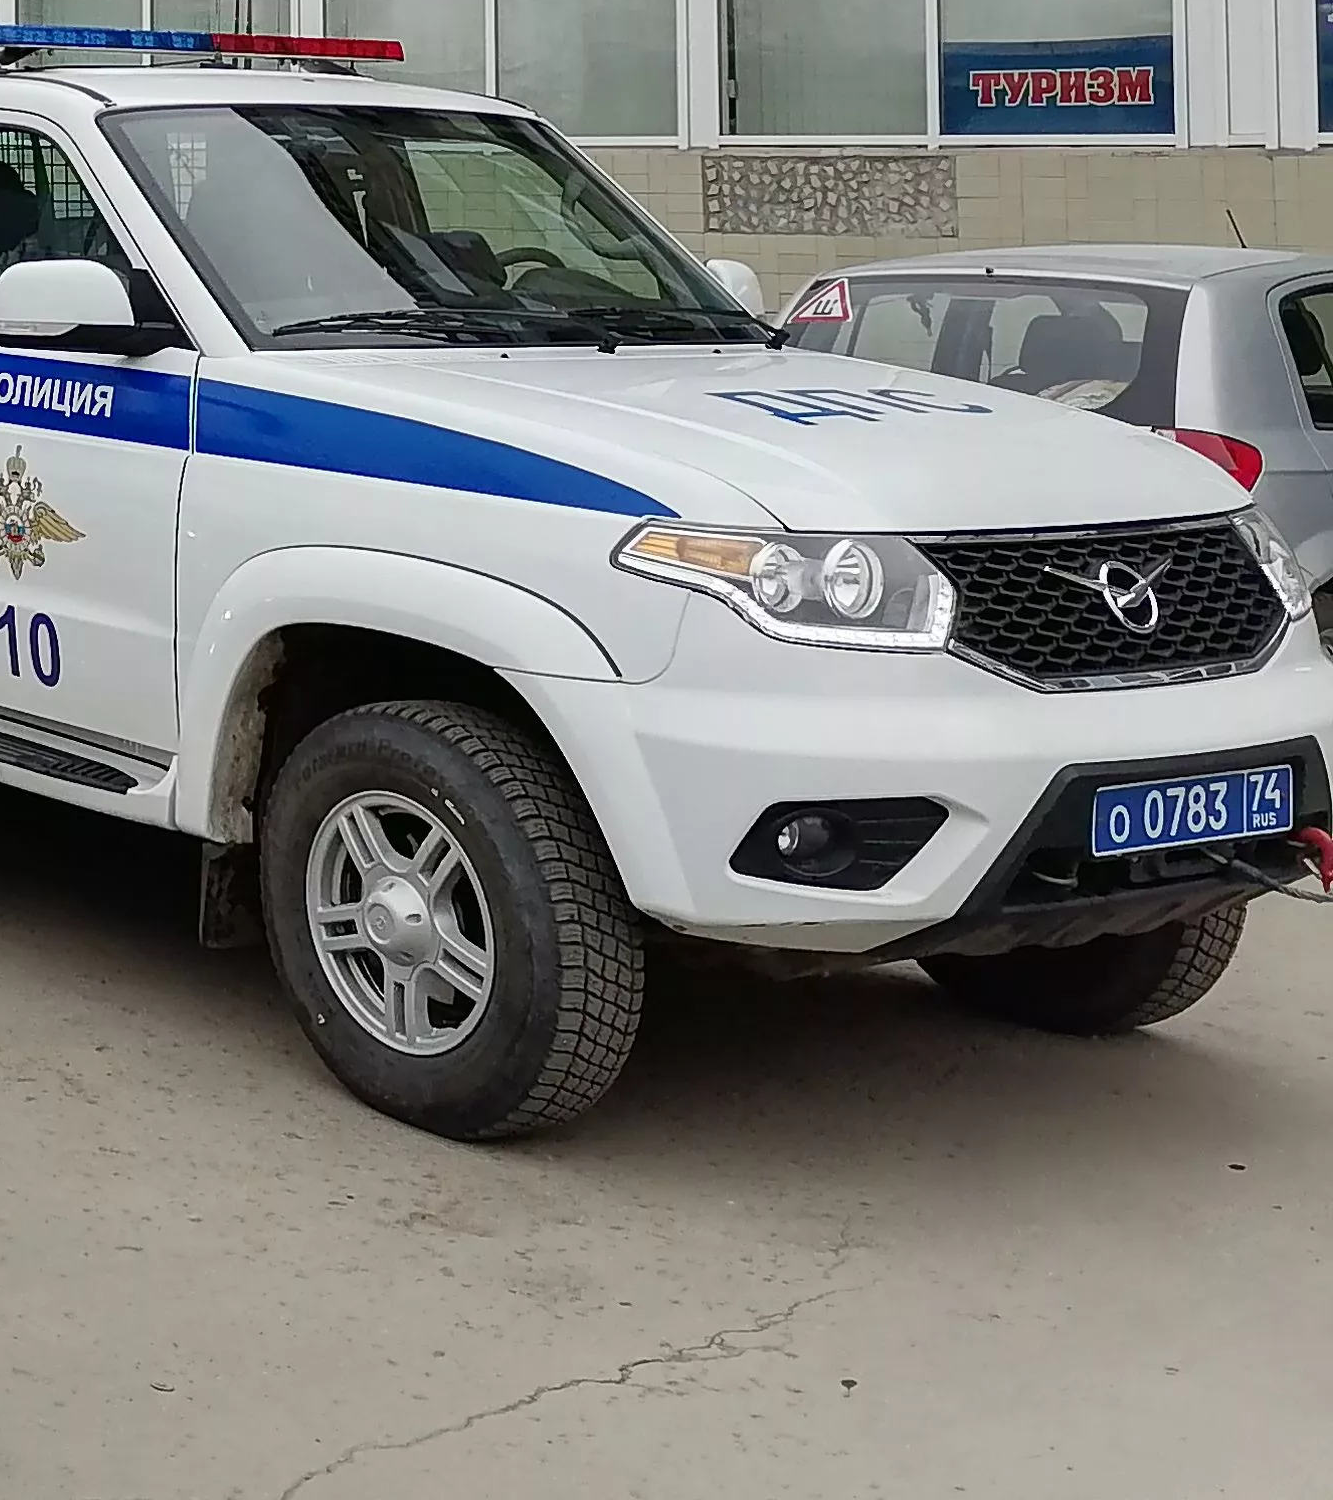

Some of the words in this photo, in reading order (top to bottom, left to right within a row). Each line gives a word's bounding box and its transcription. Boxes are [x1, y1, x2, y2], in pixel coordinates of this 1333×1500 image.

[970, 67, 1154, 106] ТУРИЗМ
[703, 388, 995, 426] ДПС
[1143, 781, 1228, 839] 0783
[1249, 772, 1281, 812] 74
[1252, 812, 1277, 828] RUS
